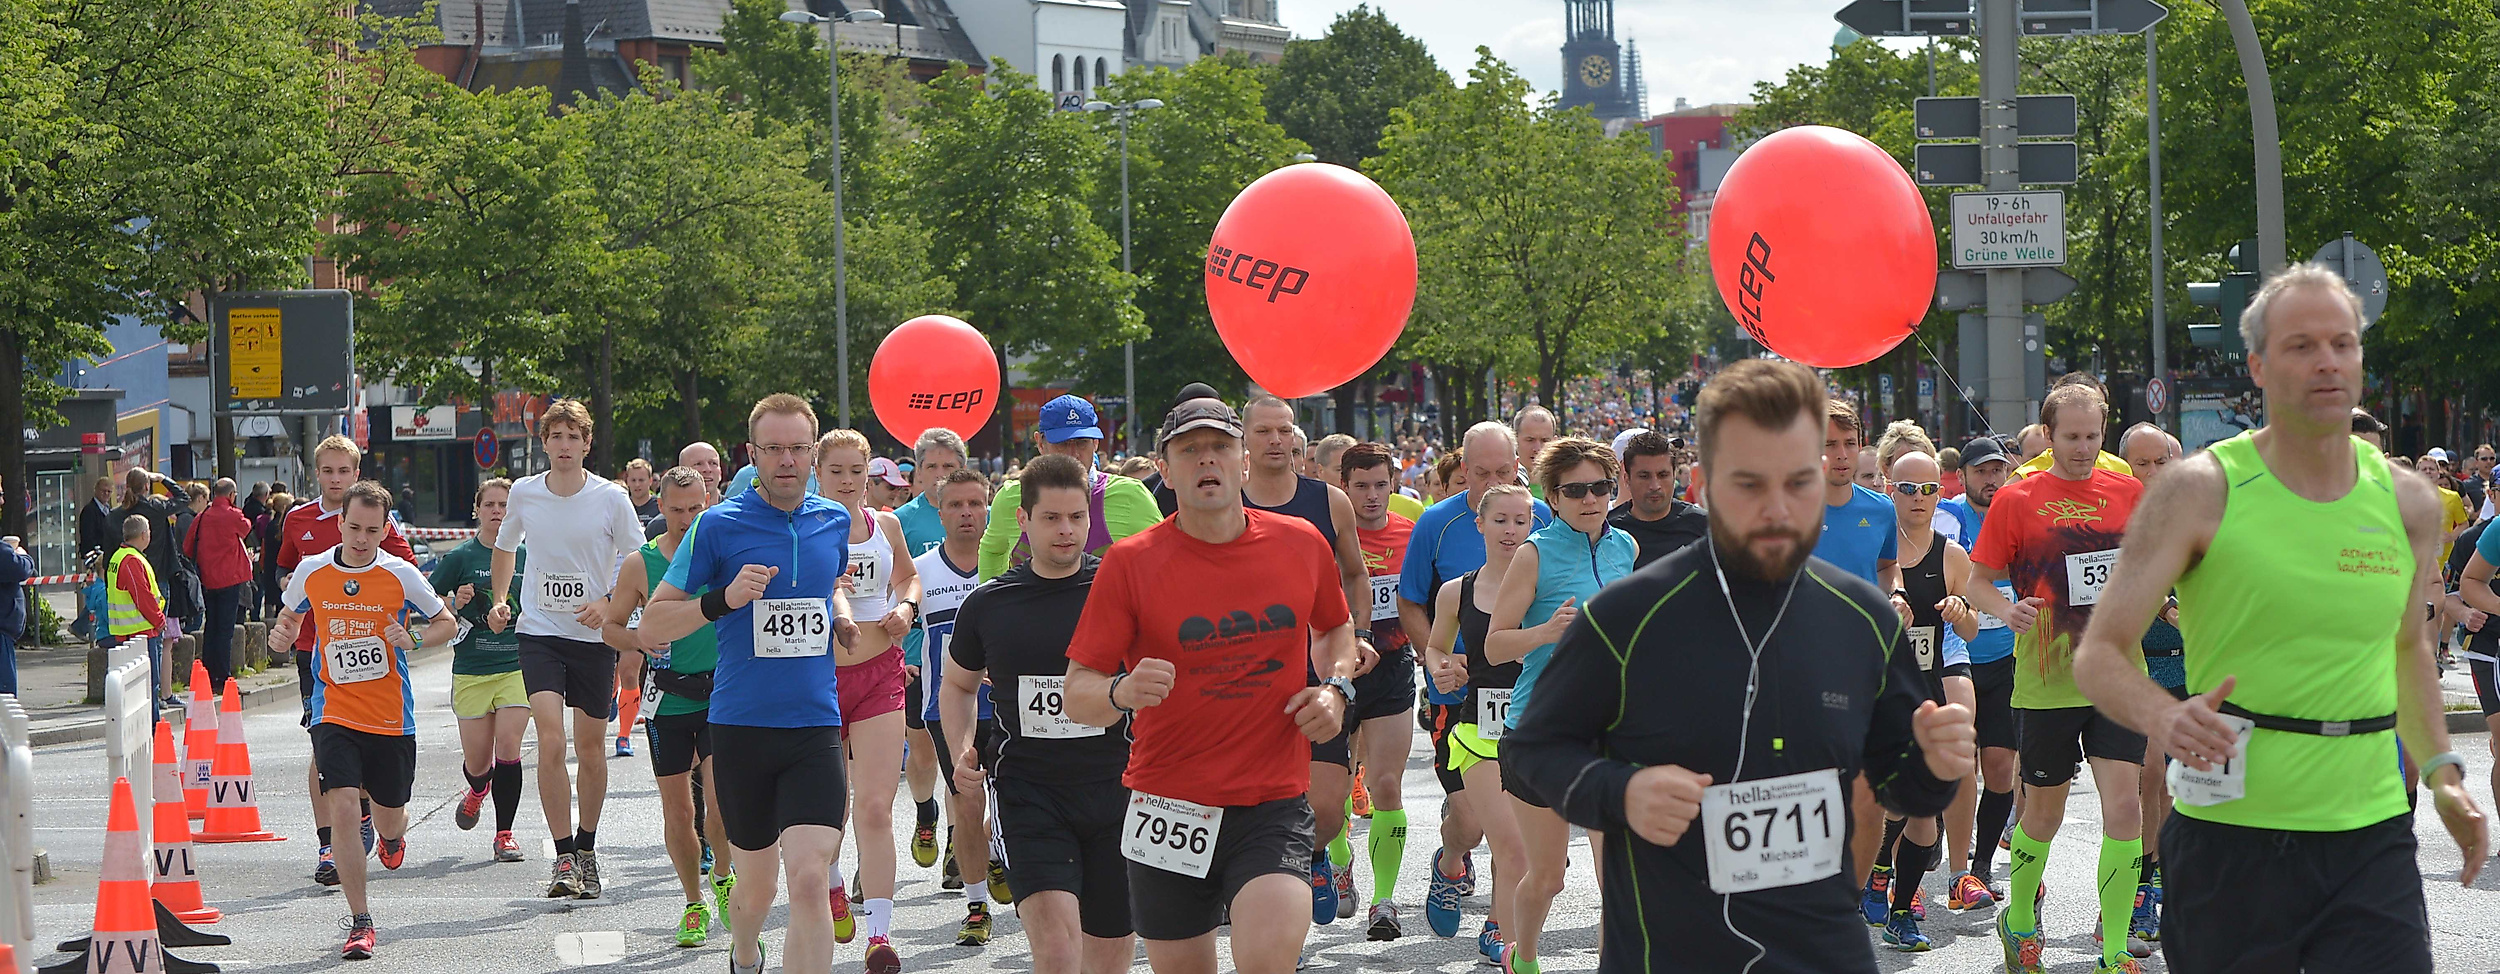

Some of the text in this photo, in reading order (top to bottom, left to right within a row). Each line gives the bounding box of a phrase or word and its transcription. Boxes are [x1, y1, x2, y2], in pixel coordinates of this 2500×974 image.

[1986, 197, 1999, 210] 19
[1968, 212, 2048, 227] Unfallgefahr
[1980, 229, 2038, 244] 30 km/h
[1964, 246, 2055, 261] Grüne Welle
[1228, 253, 1309, 304] cep
[1739, 231, 1775, 322] cep
[936, 388, 983, 413] cep
[2078, 554, 2098, 564] hella
[543, 581, 584, 598] 1008
[926, 585, 961, 598] SIGNAL
[322, 600, 384, 612] SportScheck
[768, 601, 792, 611] hella
[349, 620, 375, 630] Stadt
[763, 612, 825, 636] 4813
[349, 627, 372, 636] Lauf
[335, 642, 353, 651] hella
[334, 647, 383, 669] 1366
[345, 666, 375, 674] Constantin
[1034, 678, 1059, 689] hella
[1490, 691, 1511, 700] hella
[1032, 725, 1048, 733] hella
[1771, 782, 1807, 792] hamburg
[1146, 793, 1170, 811] hella
[1730, 786, 1771, 805] hella
[1169, 807, 1204, 818] halbmaratho
[1170, 801, 1196, 812] hamburg
[1134, 810, 1209, 854] 7956
[1724, 799, 1830, 852] 6711
[1130, 846, 1146, 858] hella
[1761, 847, 1809, 862] Michael
[1732, 870, 1759, 882] hella
